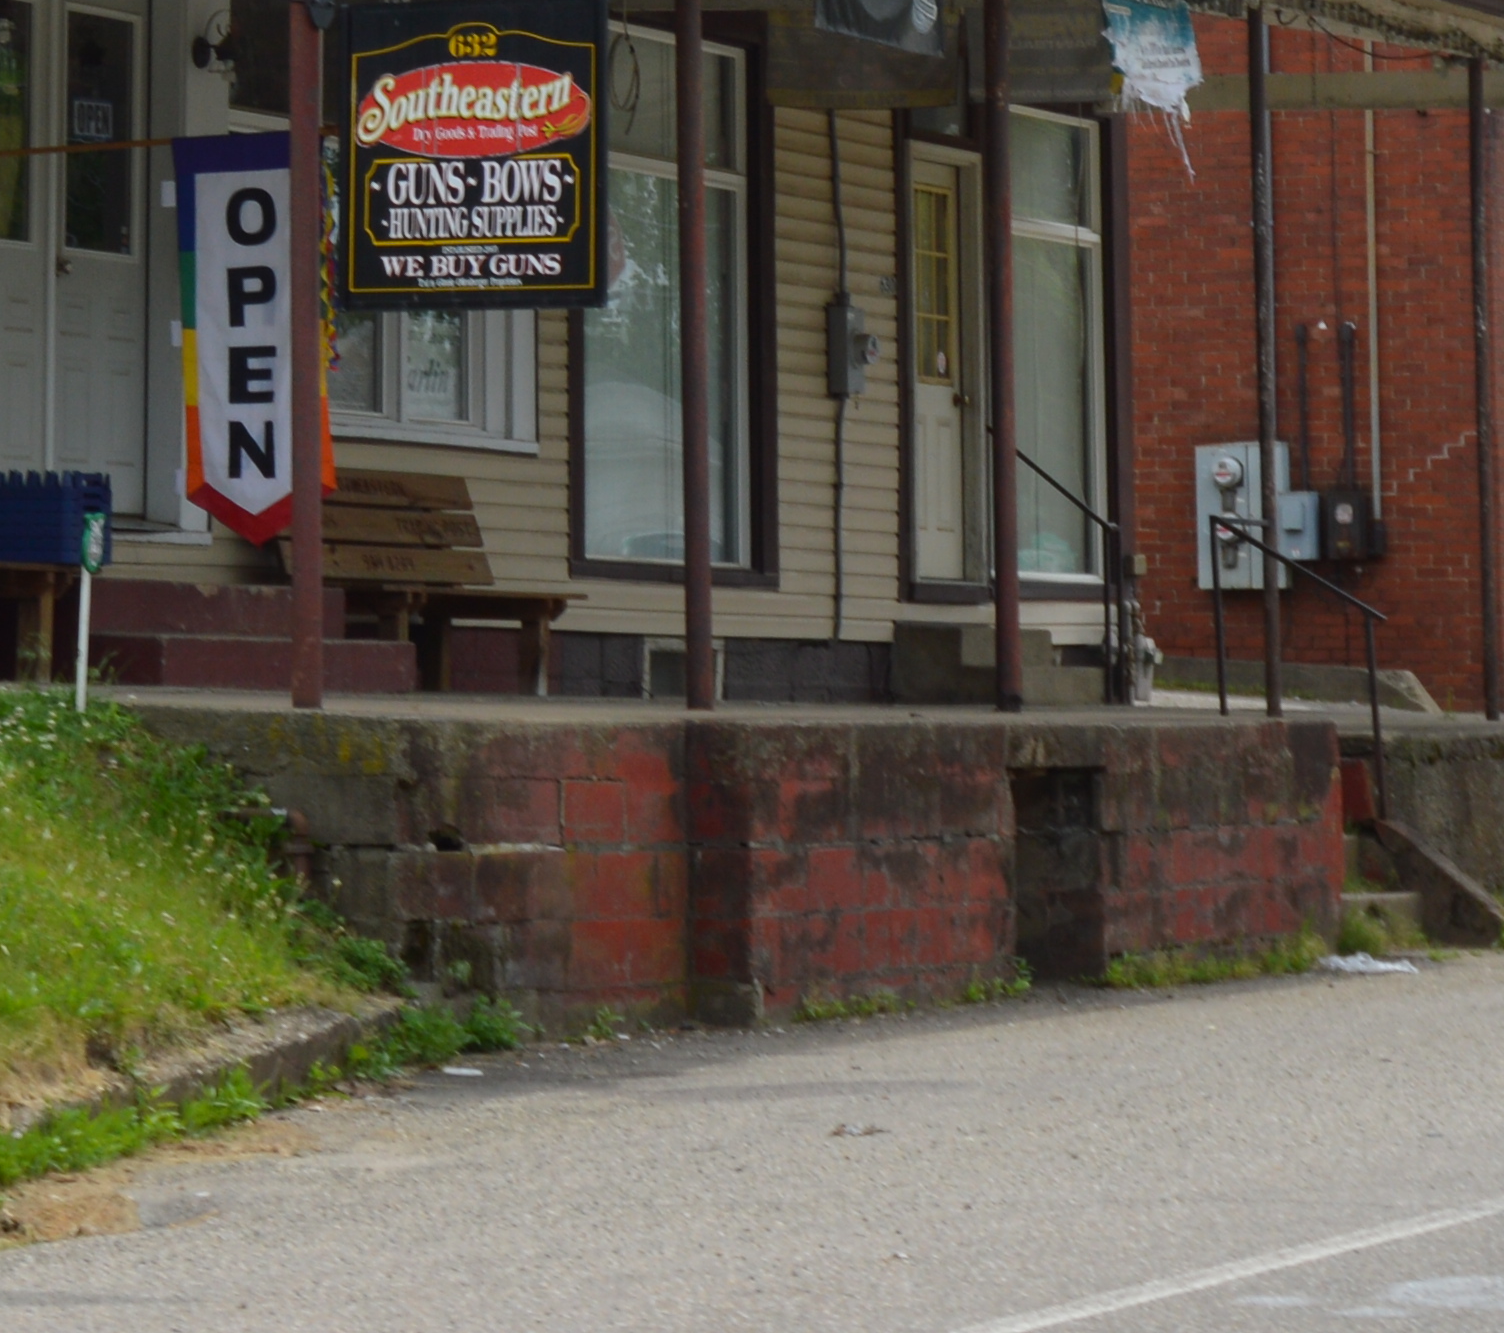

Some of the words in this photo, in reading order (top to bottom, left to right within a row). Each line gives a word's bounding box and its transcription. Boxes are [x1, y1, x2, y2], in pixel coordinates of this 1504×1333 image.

[449, 33, 498, 58] 632
[358, 73, 572, 144] Southeastern
[413, 127, 431, 145] Dry
[387, 162, 465, 205] GUNS
[481, 159, 562, 203] BOWS
[389, 206, 470, 239] HUNTING
[471, 205, 558, 237] SUPPLIES
[380, 255, 425, 277] WE
[430, 254, 488, 277] BUY
[489, 253, 562, 276] GUNS
[226, 187, 277, 478] OPEN
